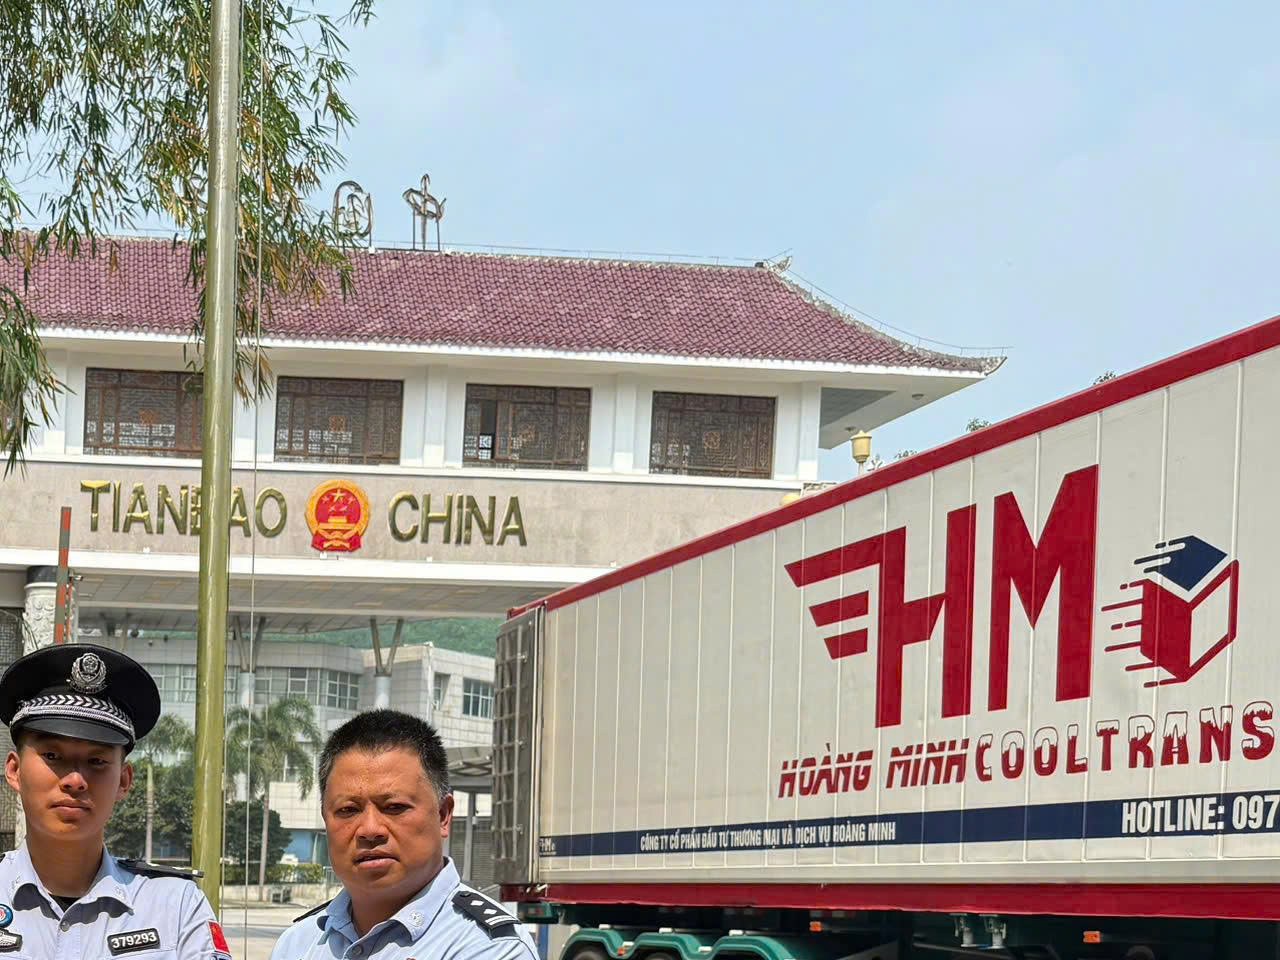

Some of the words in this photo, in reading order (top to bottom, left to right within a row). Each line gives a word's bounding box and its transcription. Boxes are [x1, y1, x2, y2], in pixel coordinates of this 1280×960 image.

[388, 491, 528, 546] CHINA
[778, 743, 874, 798] HOÀNG
[886, 738, 969, 788] MINH
[975, 700, 1276, 782] COOLTRANS
[1121, 797, 1225, 834] HOTLINE:
[1232, 794, 1280, 829] 097
[640, 833, 659, 851] CÔNG
[660, 835, 669, 850] TY
[719, 830, 729, 847] TƯ
[730, 828, 761, 847] THƯƠNG
[763, 829, 780, 849] MẠI
[781, 824, 793, 845] VÀ
[795, 826, 816, 848] DỊCH
[818, 825, 831, 847] VỤ
[832, 820, 866, 842] HOÀNG
[867, 821, 896, 841] MINH
[111, 933, 157, 949] 379293
